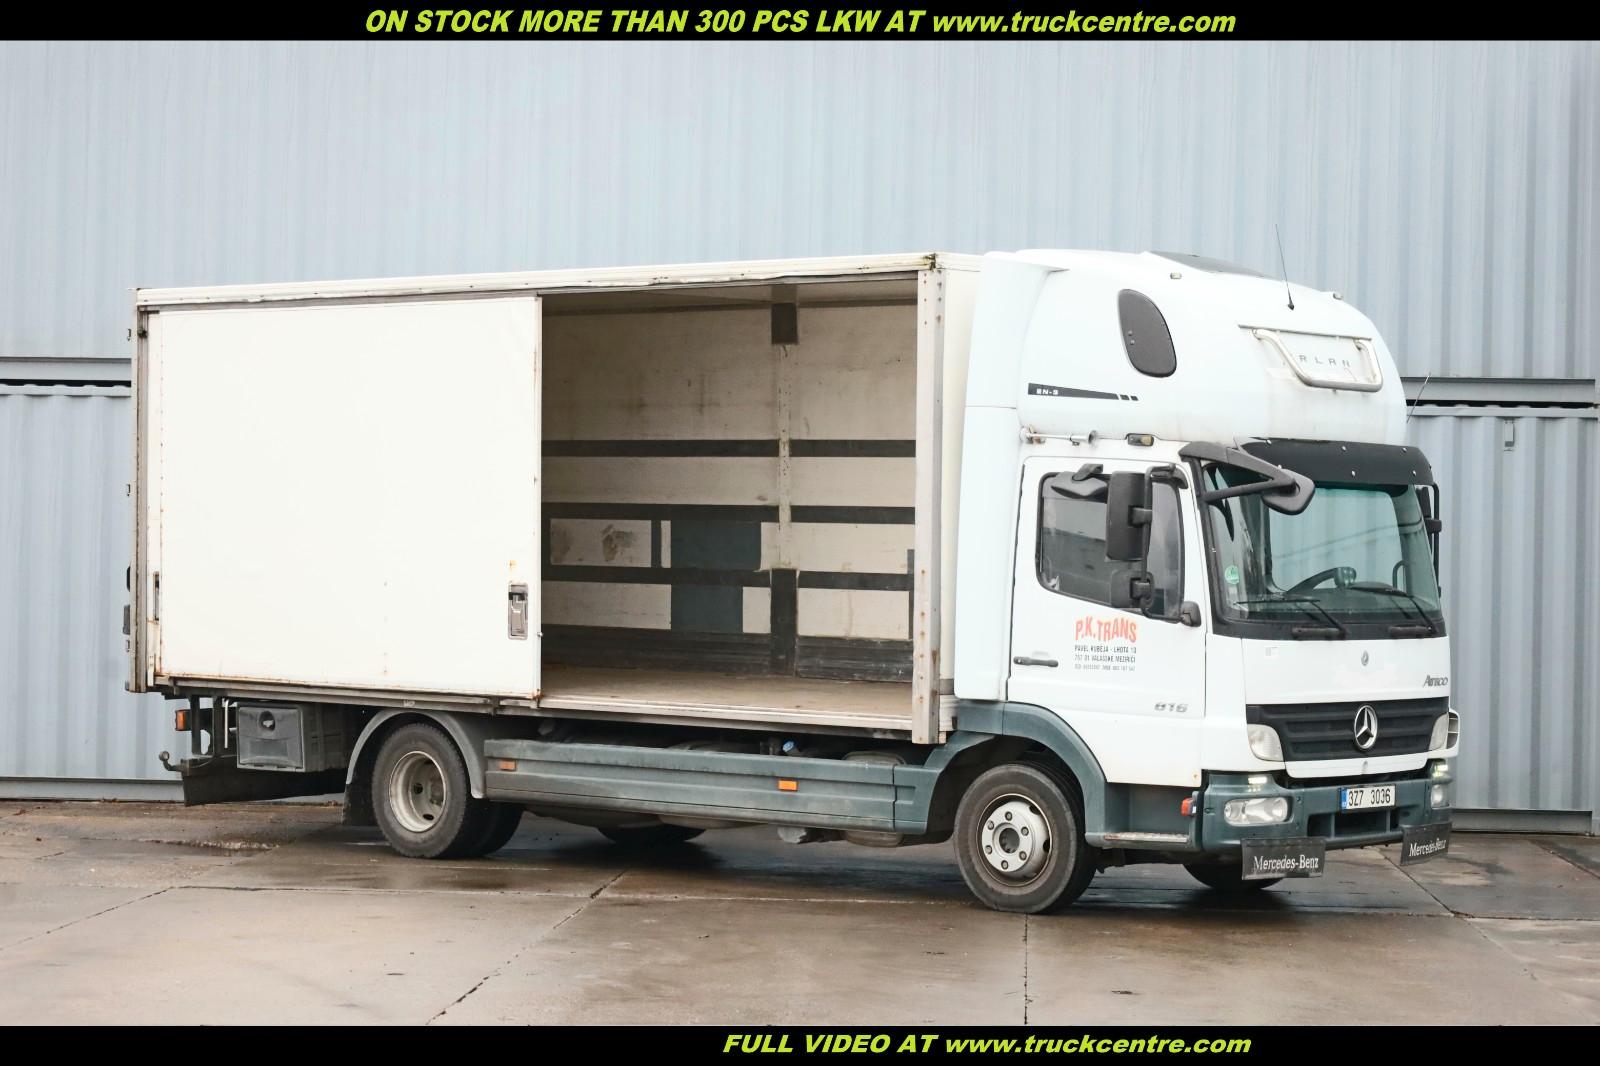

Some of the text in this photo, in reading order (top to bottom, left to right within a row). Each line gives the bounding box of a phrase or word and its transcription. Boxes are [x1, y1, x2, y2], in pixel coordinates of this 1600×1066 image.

[1348, 790, 1364, 807] 3Z7
[1370, 788, 1391, 805] 3036
[1253, 854, 1319, 871] Mercedes-Benz
